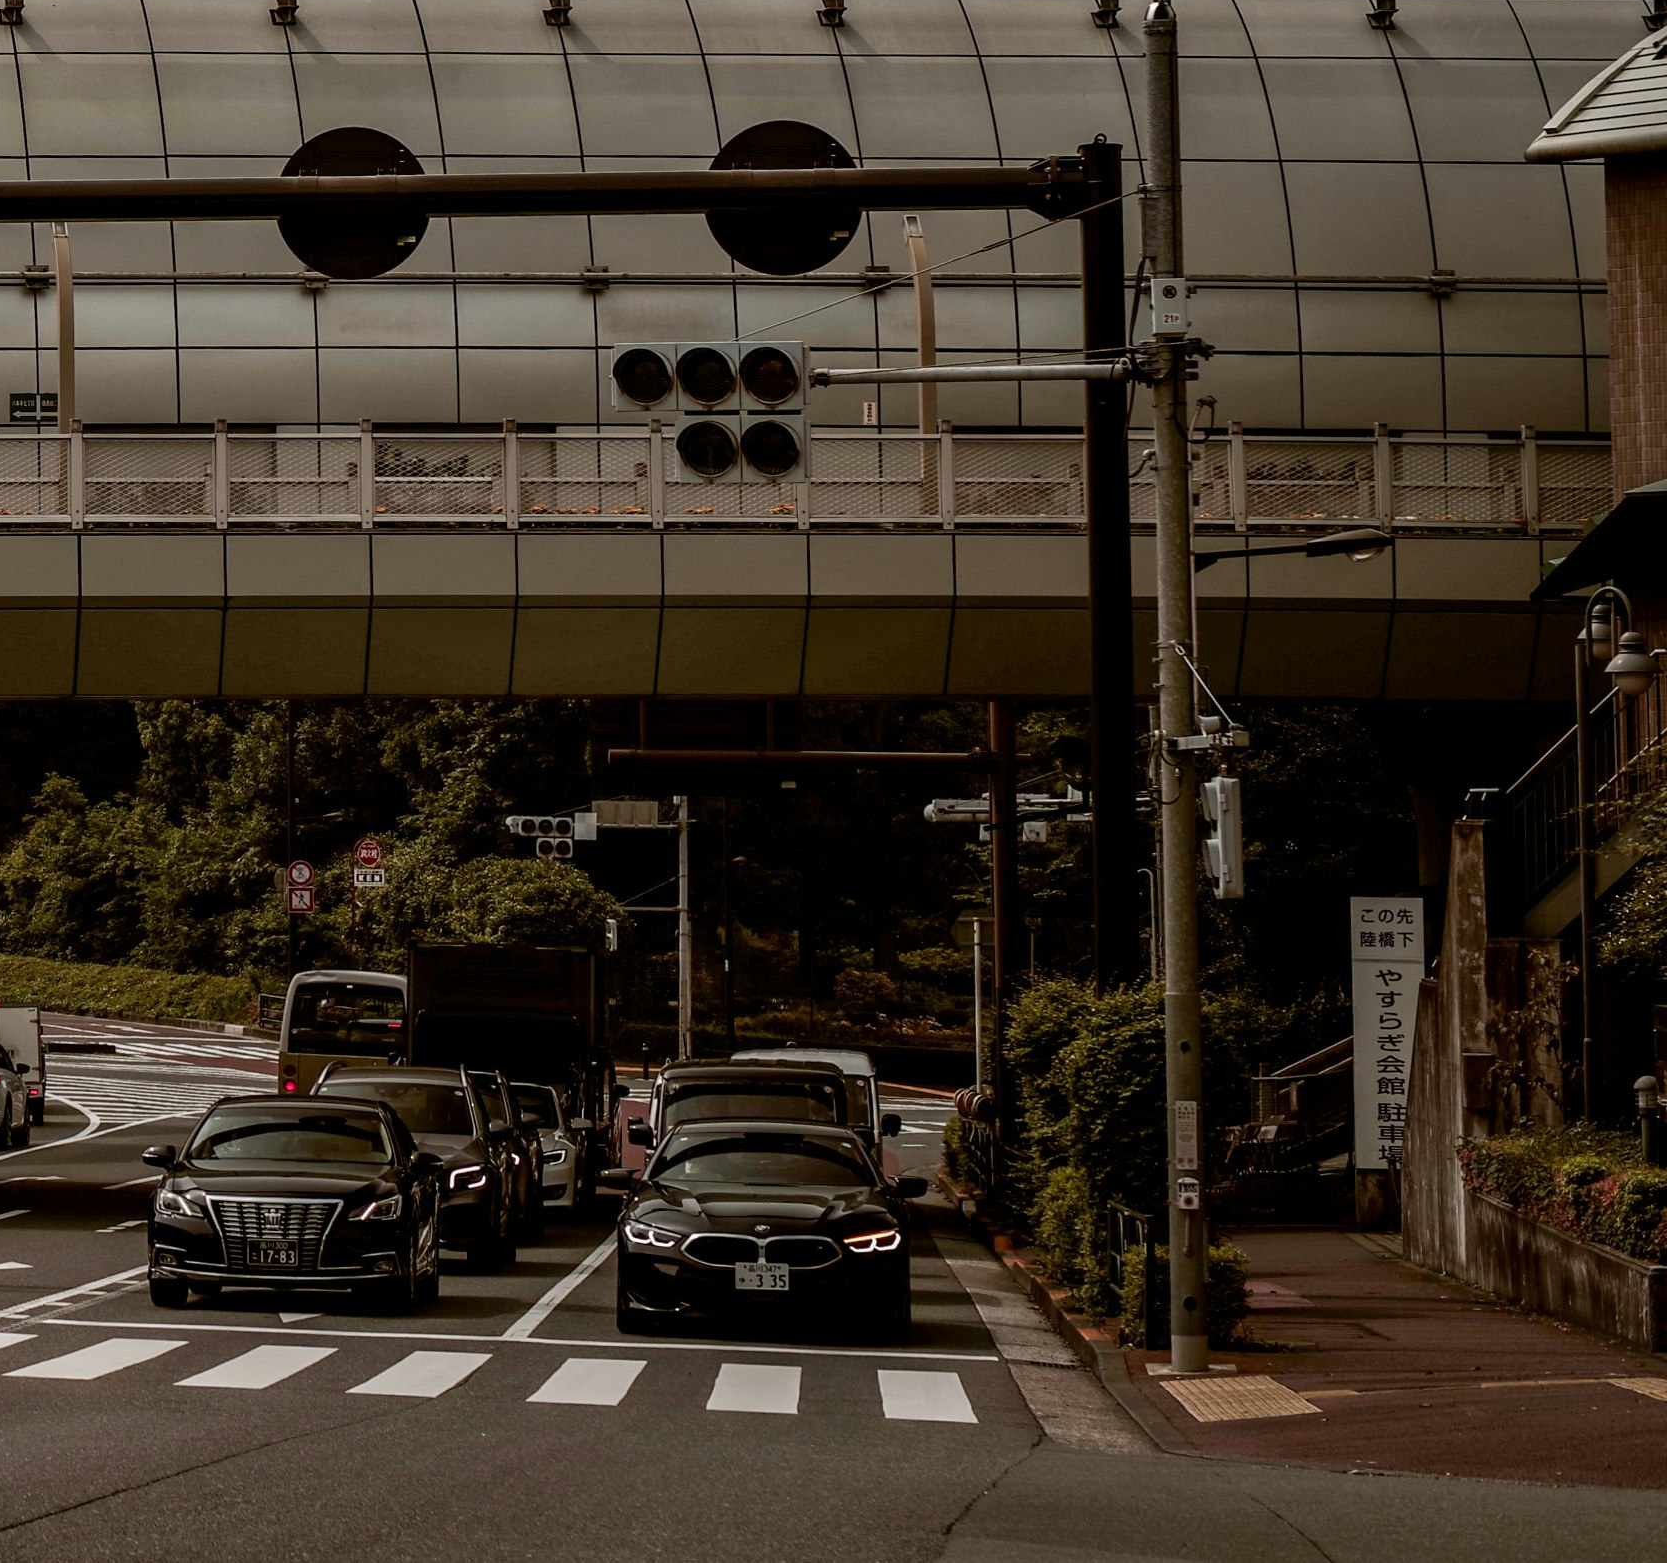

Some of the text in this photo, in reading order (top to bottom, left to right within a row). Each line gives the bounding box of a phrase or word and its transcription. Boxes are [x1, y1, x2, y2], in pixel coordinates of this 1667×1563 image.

[1361, 909, 1413, 925] この先
[1360, 931, 1414, 948] 陸橋下
[1376, 970, 1407, 1163] やすらぎ会館 駐車場
[260, 1250, 295, 1263] 17-83
